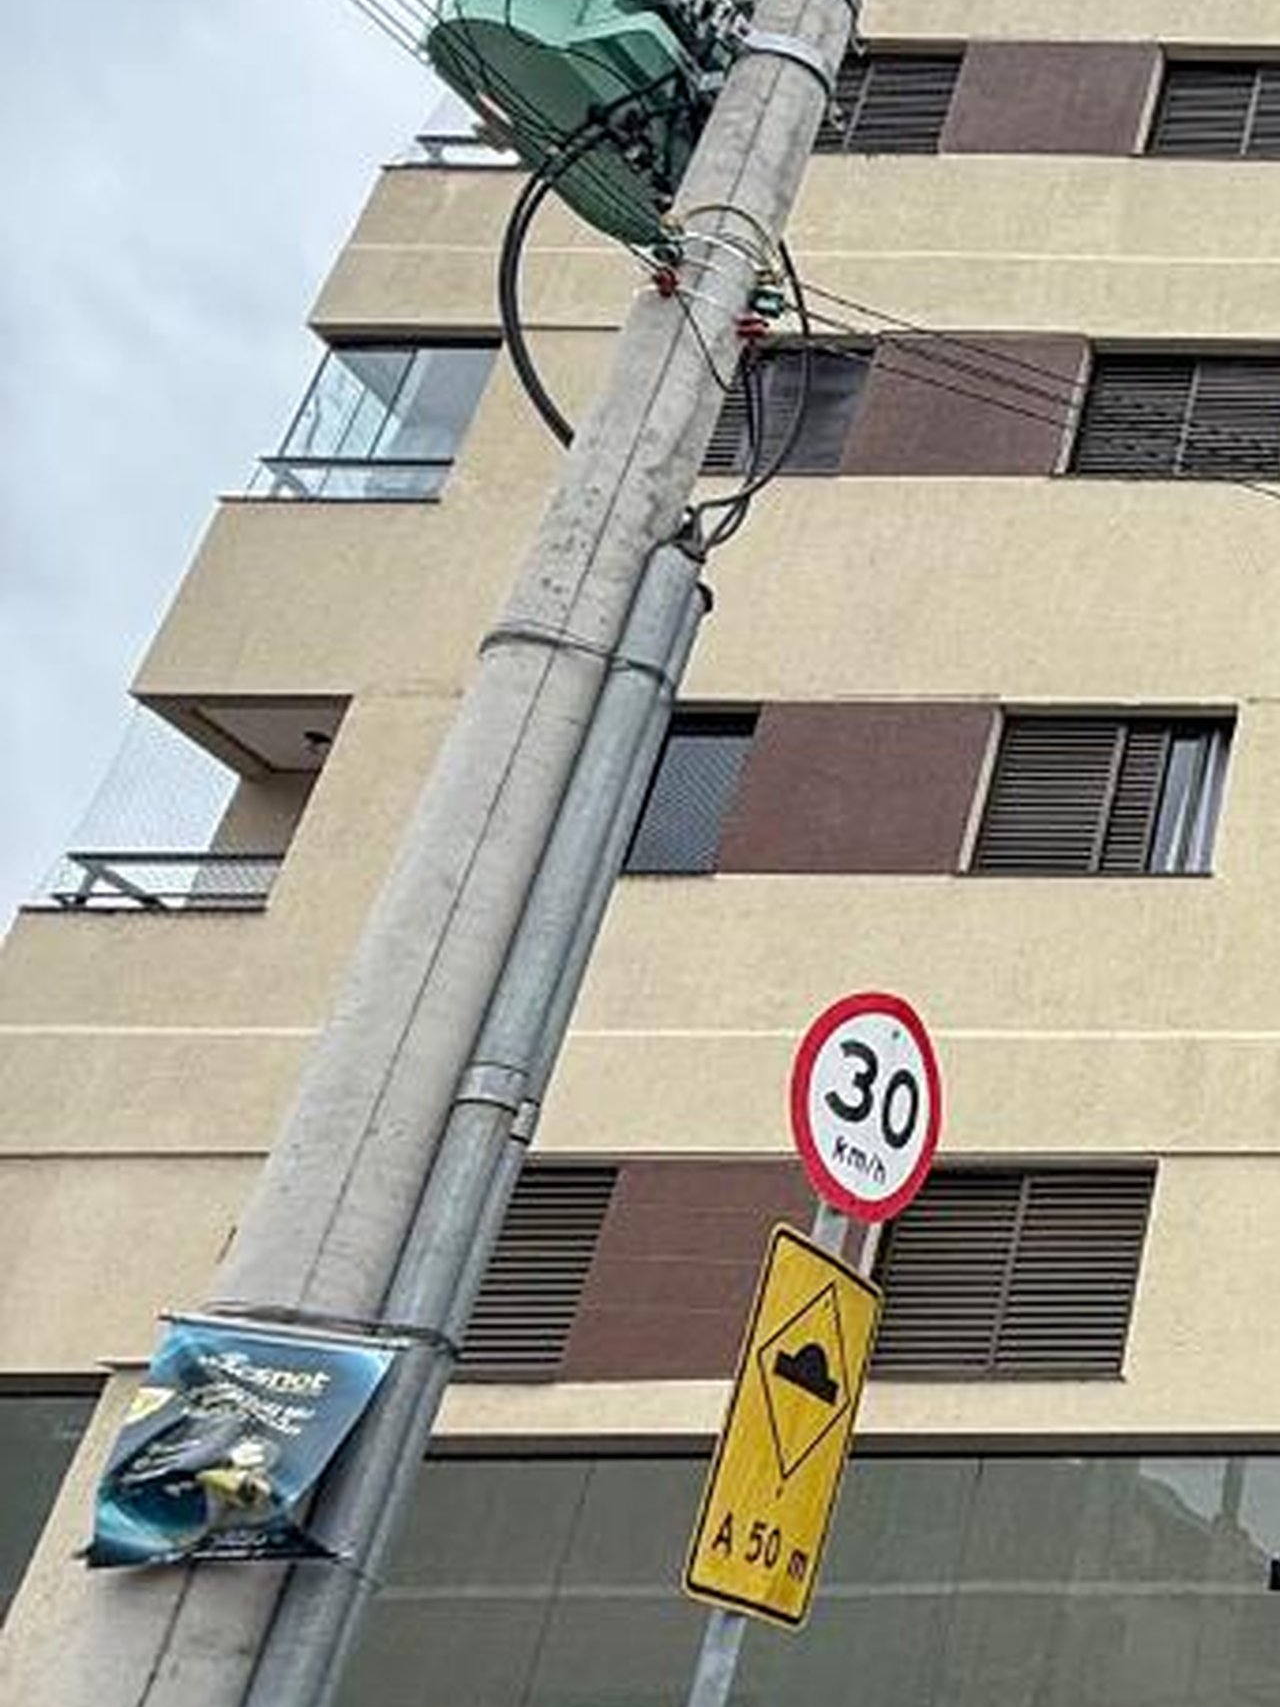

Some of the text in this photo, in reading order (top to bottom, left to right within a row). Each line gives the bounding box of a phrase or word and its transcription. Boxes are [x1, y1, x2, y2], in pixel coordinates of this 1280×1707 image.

[824, 1040, 920, 1150] 30
[832, 1135, 887, 1185] km/h
[711, 1511, 808, 1583] A 50 m
